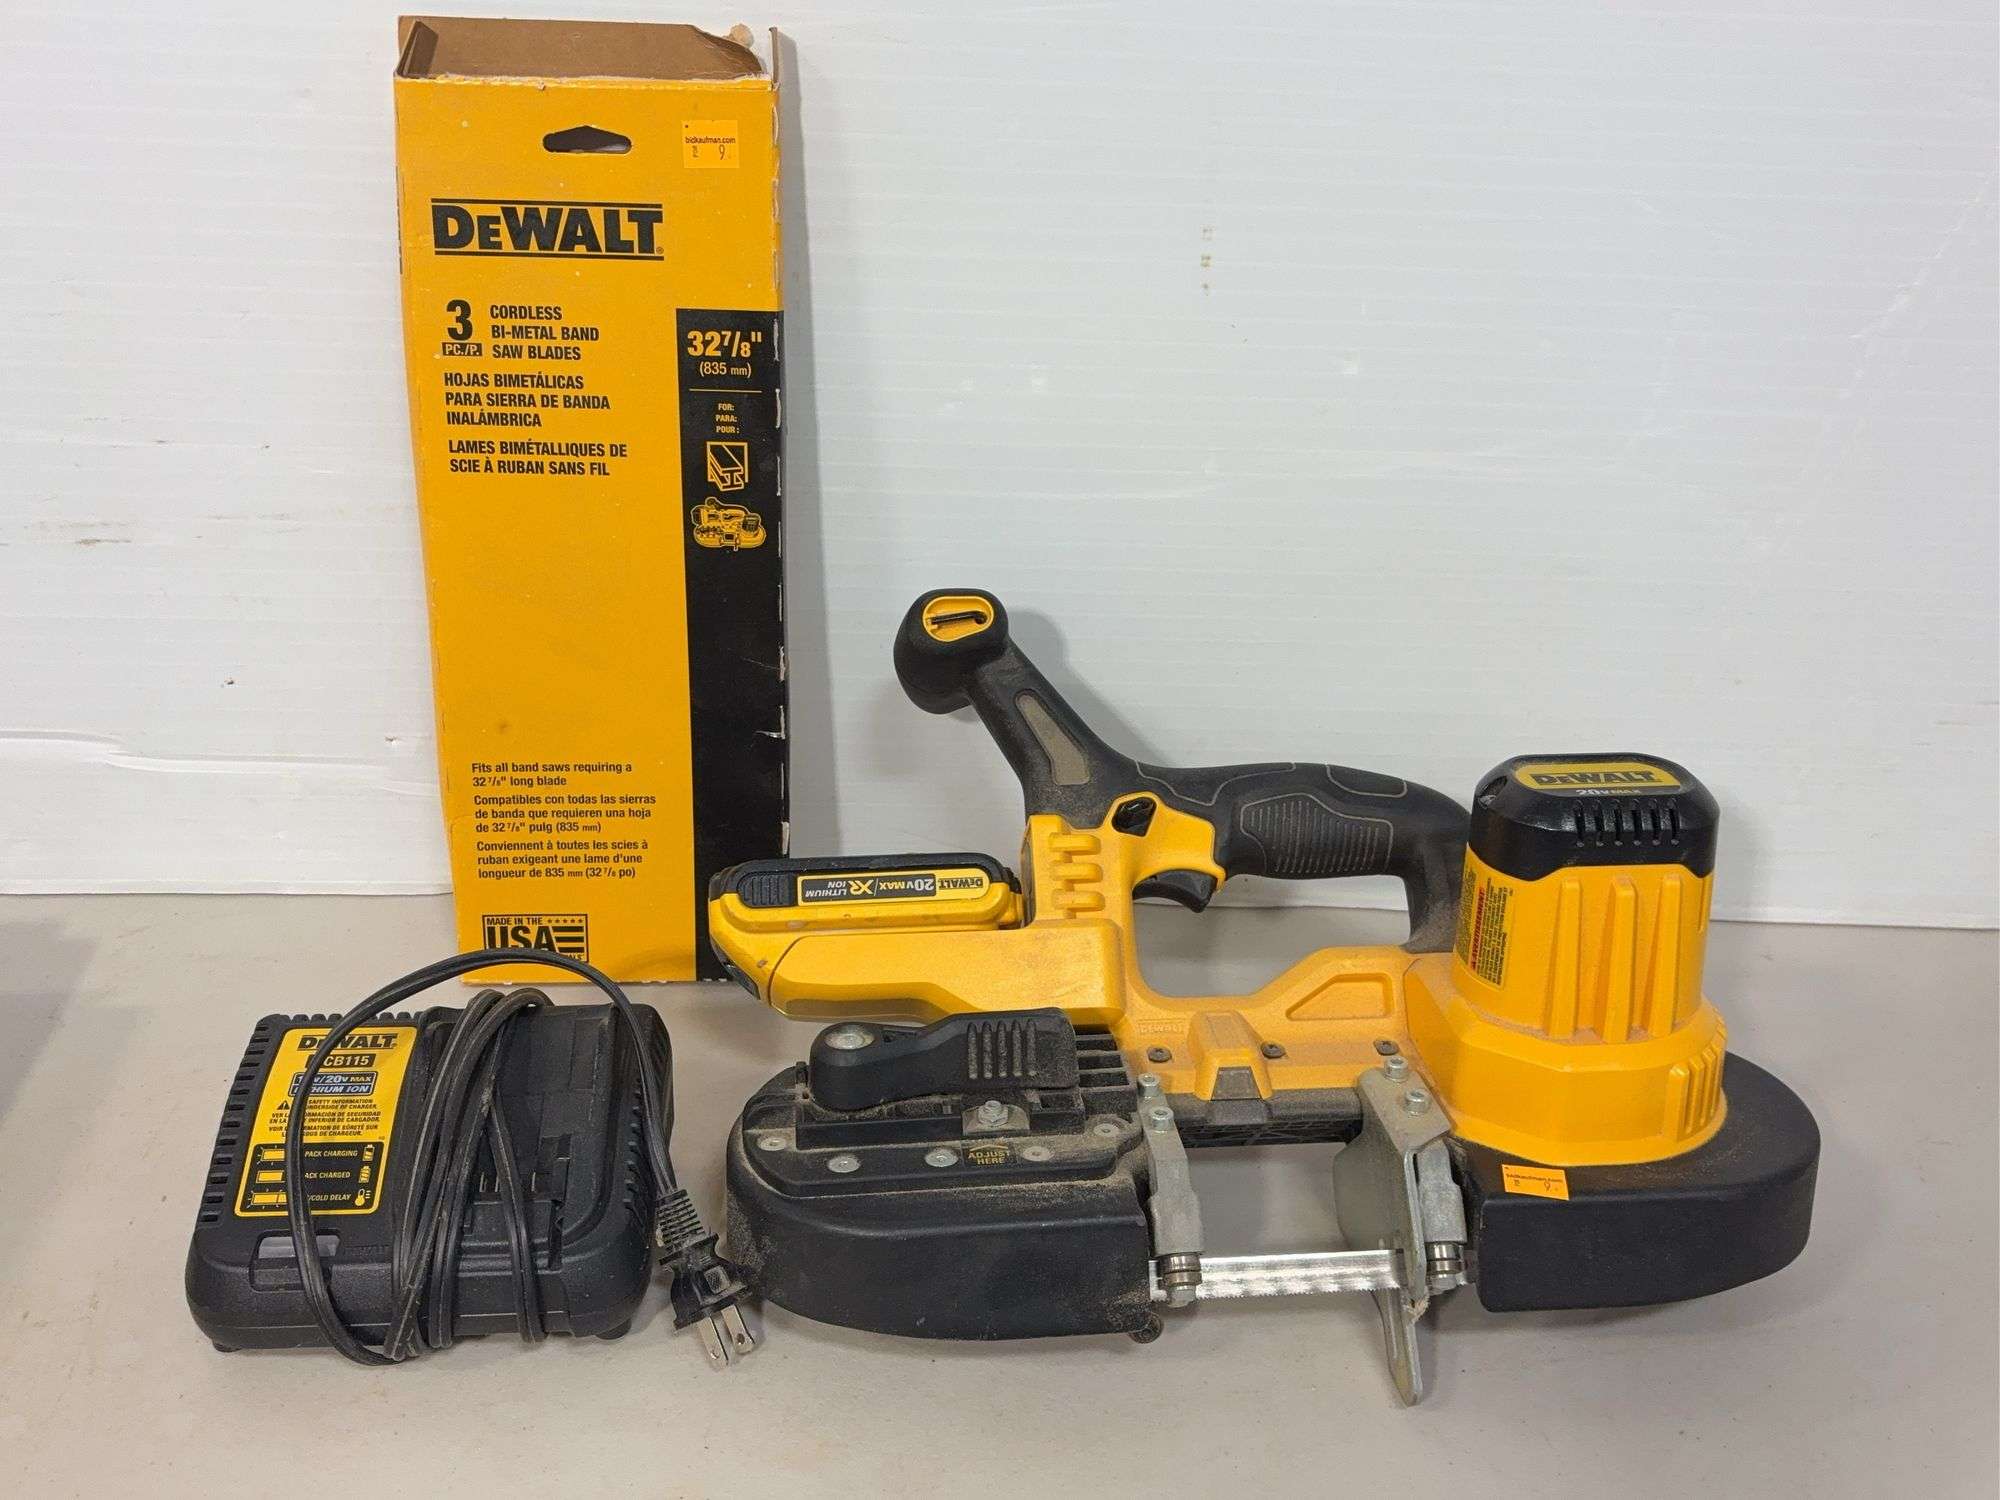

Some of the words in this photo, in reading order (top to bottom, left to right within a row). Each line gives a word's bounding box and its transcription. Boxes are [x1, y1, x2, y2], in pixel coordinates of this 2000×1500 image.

[432, 204, 663, 254] DEWALT
[447, 300, 472, 340] 3
[490, 305, 562, 321] CORDLESS
[492, 325, 557, 340] BI-METAL
[562, 327, 599, 341] BAND
[493, 344, 525, 359] SAW
[528, 345, 581, 360] BLADES
[700, 362, 727, 377] (835
[731, 362, 751, 378] mm)
[444, 373, 489, 387] HOJAS
[494, 372, 583, 389] BIMETÁLICAS
[446, 392, 482, 406] PARA
[487, 393, 536, 407] SIERRA
[541, 395, 558, 408] DE
[563, 395, 610, 409] BANDA
[447, 409, 542, 427] INALÁMBRICA
[449, 440, 495, 454] LAMES
[500, 438, 605, 457] BIMÉTALLIQUES
[610, 444, 627, 457] DE
[450, 459, 480, 472] SCIE
[484, 457, 493, 473] À
[498, 460, 544, 474] RUBAN
[550, 462, 585, 475] SANS
[590, 463, 609, 476] FIL
[472, 763, 491, 772] Fits
[496, 763, 508, 772] all
[512, 763, 538, 772] band
[574, 762, 622, 774] requiring
[510, 777, 533, 787] long
[537, 776, 566, 785] blade
[1531, 772, 1661, 784] DEWALT
[475, 795, 541, 806] Compatibles
[568, 795, 597, 804] todas
[601, 795, 616, 803] las
[619, 794, 656, 803] sierras
[475, 809, 488, 818] de
[492, 809, 524, 818] banda
[529, 810, 548, 820] que
[551, 809, 601, 819] requieren
[629, 808, 650, 819] hoja
[476, 823, 488, 832] de
[529, 822, 552, 833] pulg
[556, 822, 579, 833] (835
[582, 822, 601, 832] mm)
[477, 841, 543, 851] Conviennent
[547, 841, 552, 850] à
[557, 841, 589, 850] toutes
[593, 840, 608, 849] les
[611, 840, 638, 849] scies
[642, 840, 648, 849] à
[478, 855, 508, 864] ruban
[512, 855, 557, 865] exigeant
[584, 854, 609, 863] lame
[613, 854, 642, 863] d'une
[479, 869, 524, 880] longueur
[530, 869, 542, 878] de
[545, 869, 564, 877] 835
[619, 868, 635, 878] po)
[849, 880, 874, 895] XR
[879, 882, 904, 890] MAX
[938, 877, 983, 890] DEWALT
[805, 889, 846, 897] LITHIUM
[527, 917, 542, 925] THE
[487, 926, 556, 952] USA
